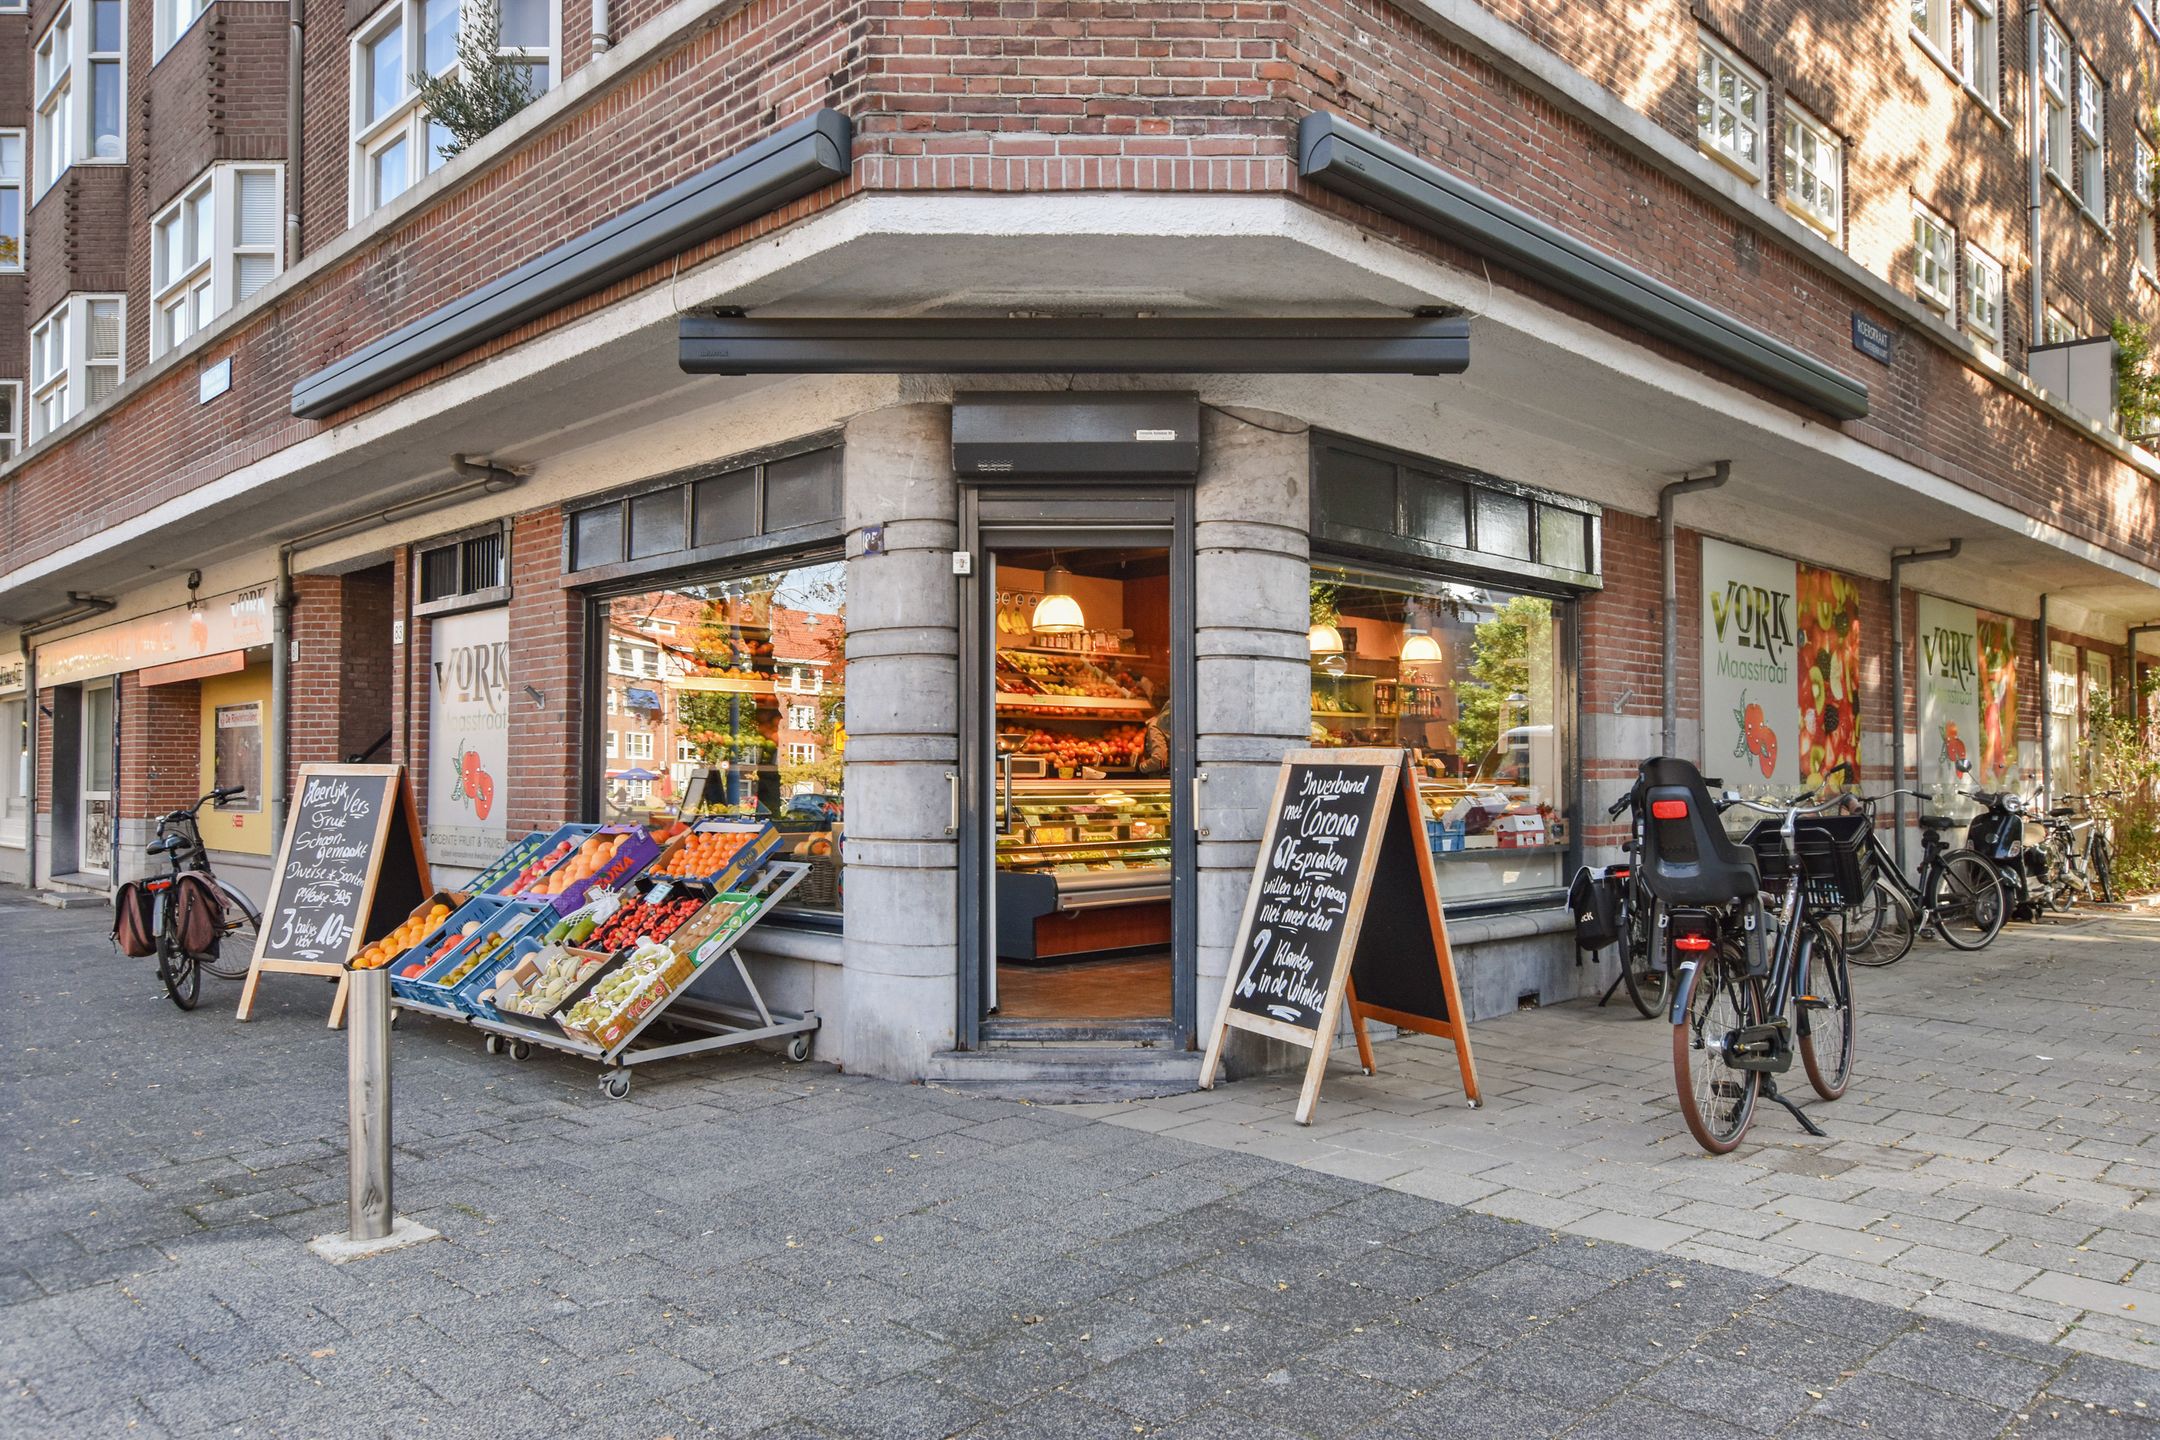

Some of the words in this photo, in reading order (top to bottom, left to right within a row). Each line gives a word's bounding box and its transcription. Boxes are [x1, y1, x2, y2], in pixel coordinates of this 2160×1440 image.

[1709, 580, 1794, 666] VORK
[1717, 650, 1788, 684] Maasstraat
[1922, 626, 1976, 692] VORK
[343, 787, 369, 814] Vers
[1283, 799, 1305, 820] met
[1301, 796, 1359, 837] Corona
[311, 809, 347, 828] Fruit
[285, 861, 327, 879] Diverse
[312, 841, 369, 867] gemaakt
[1263, 875, 1292, 895] willen
[1293, 880, 1313, 906] wij
[1310, 883, 1348, 914] graag
[271, 908, 297, 949] 3
[1260, 904, 1282, 923] niet
[1281, 908, 1308, 926] meer
[1306, 907, 1334, 932] dan
[1235, 928, 1272, 998] 2
[1272, 939, 1314, 974] Klanten
[1258, 968, 1272, 993] in
[1270, 970, 1288, 998] de
